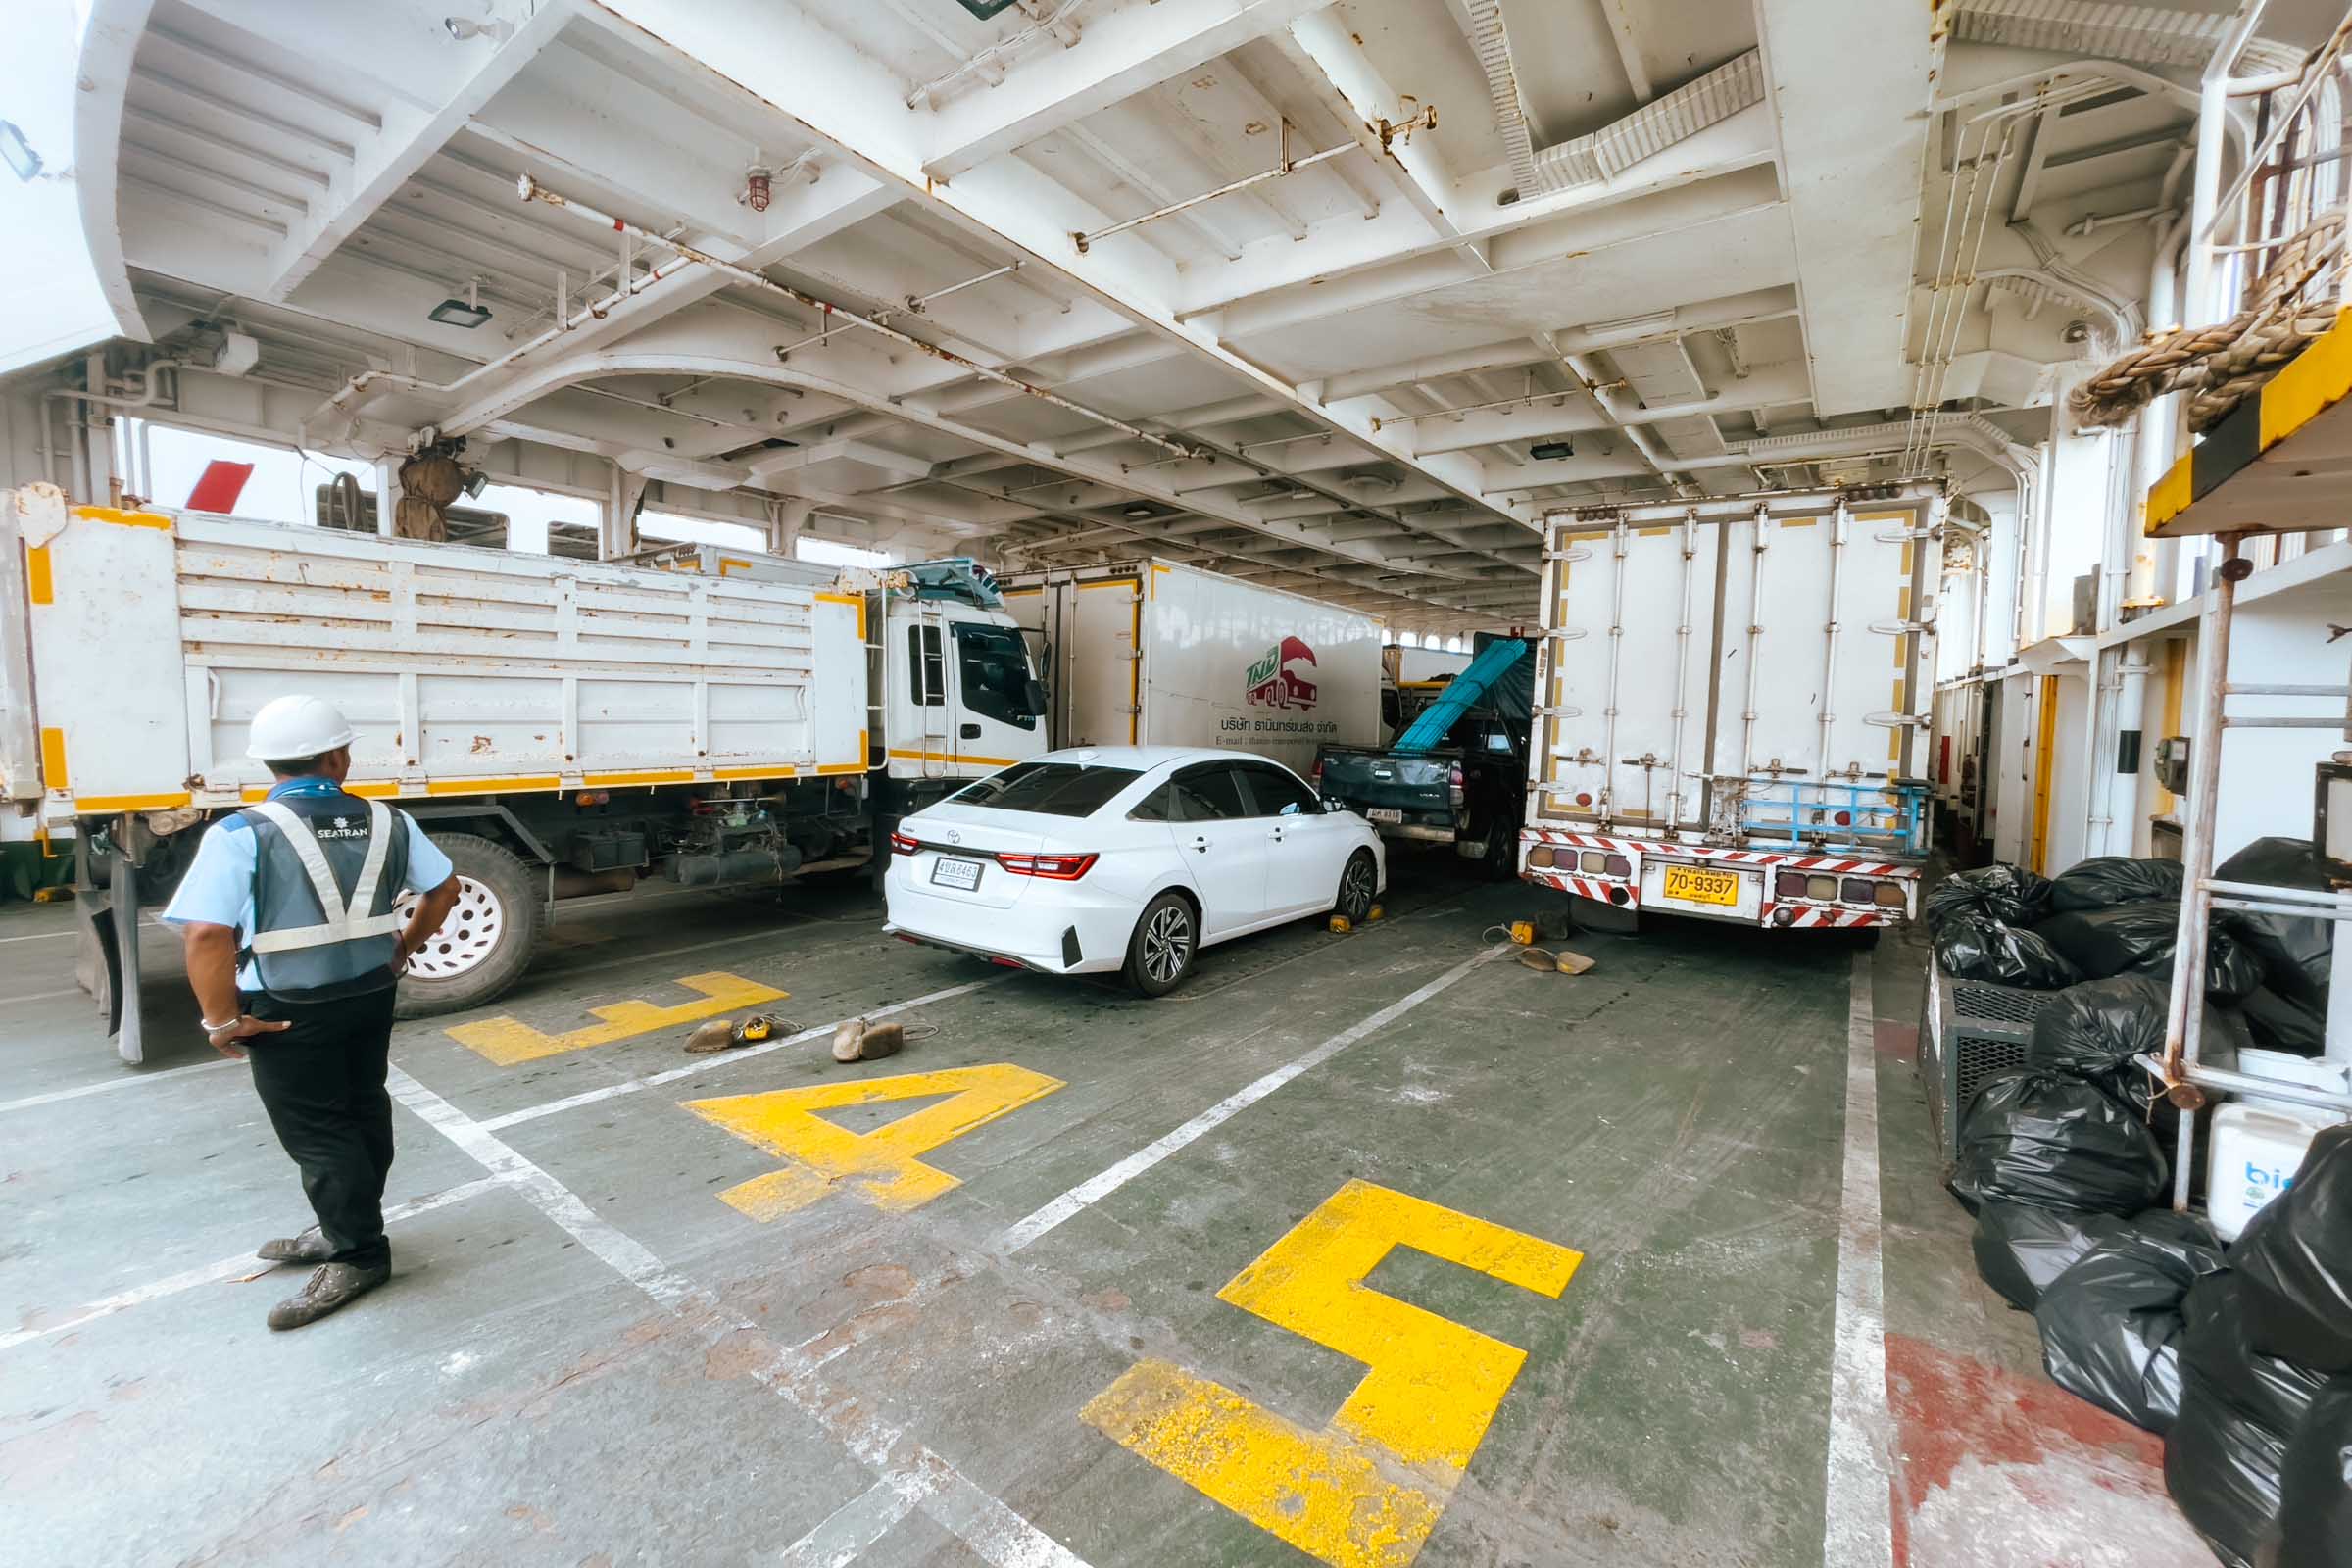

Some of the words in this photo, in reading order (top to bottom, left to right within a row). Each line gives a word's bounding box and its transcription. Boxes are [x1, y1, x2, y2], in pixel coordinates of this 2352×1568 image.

[1221, 716, 1250, 731] บริษัท
[1316, 720, 1337, 733] จำกัด
[318, 827, 368, 839] SEATRAN
[1669, 872, 1734, 894] 70-9337
[680, 1062, 1067, 1223] 4
[1079, 1178, 1586, 1568] 5
